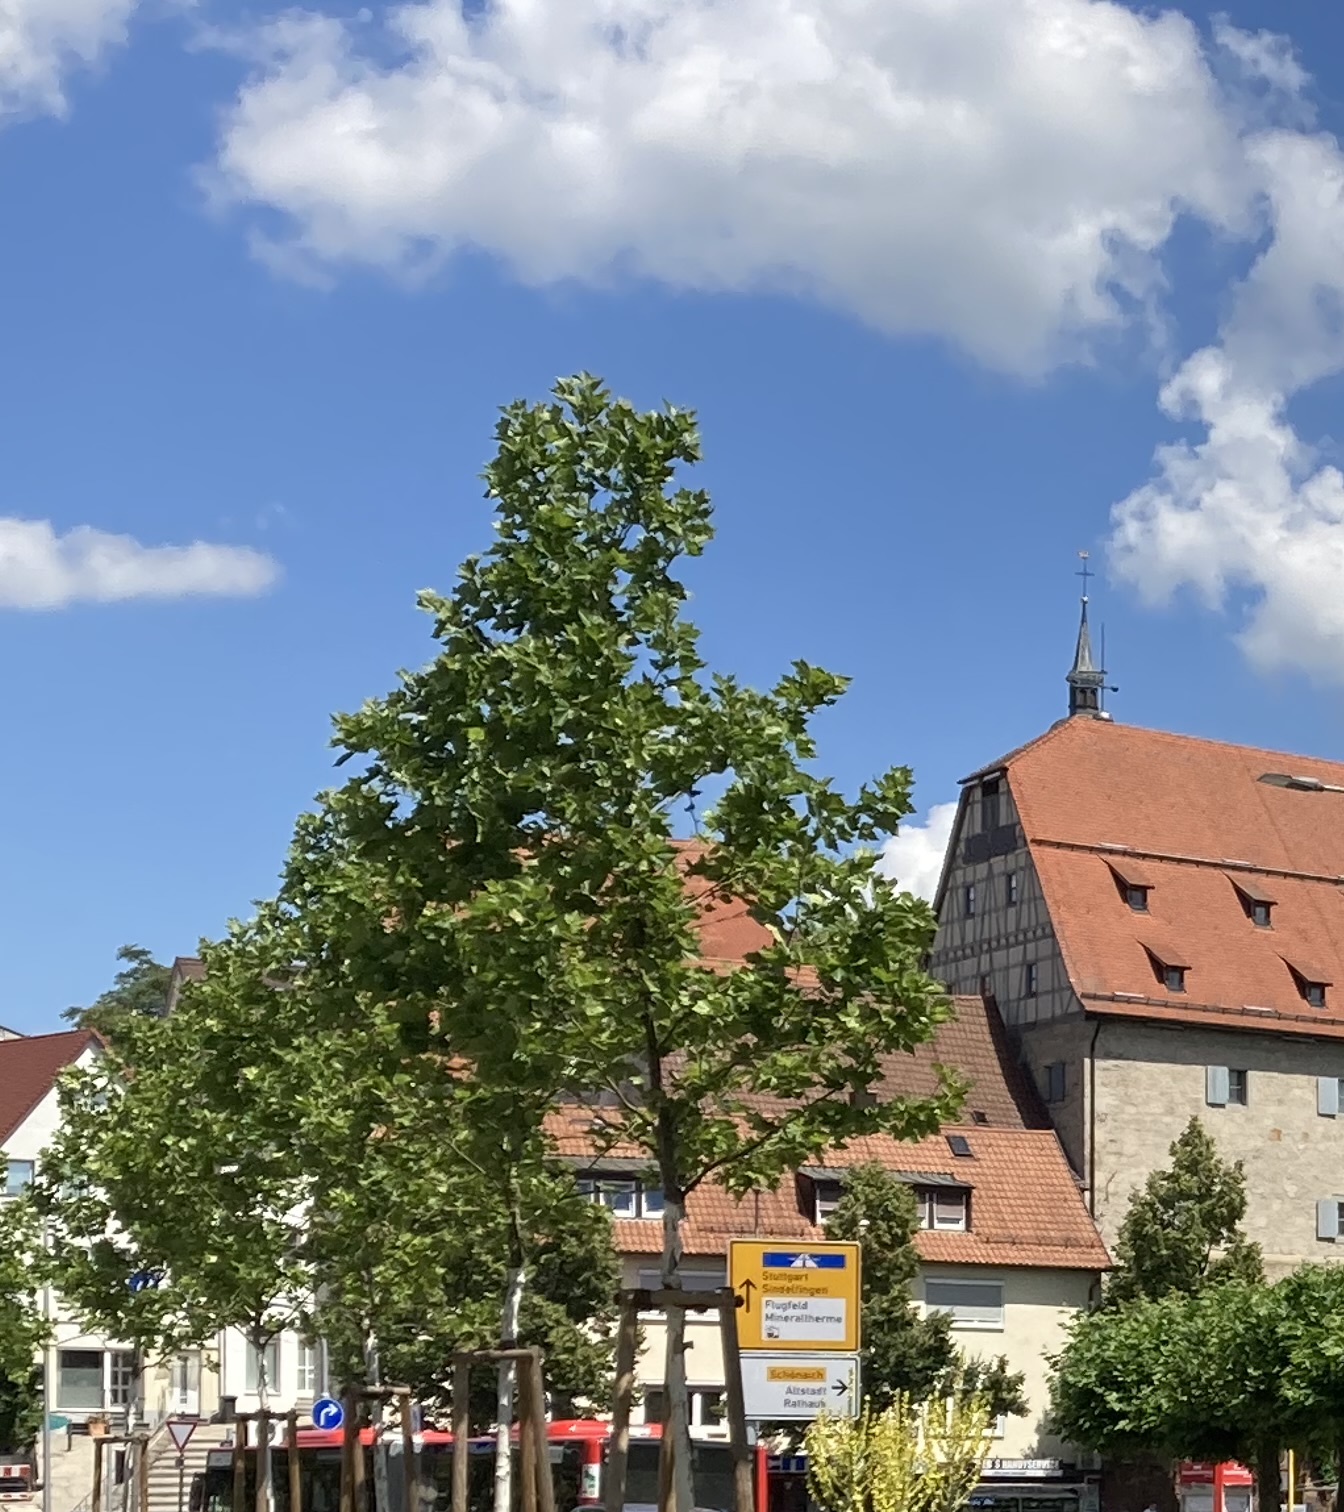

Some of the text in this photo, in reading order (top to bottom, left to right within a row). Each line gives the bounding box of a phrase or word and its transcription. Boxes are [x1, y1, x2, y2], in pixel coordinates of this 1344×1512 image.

[762, 1271, 808, 1283] Stuttgart
[762, 1284, 828, 1296] Sindelfingen
[765, 1300, 808, 1312] Flugfeld
[765, 1313, 842, 1323] Mineraltherme
[785, 1385, 826, 1395] Altstadt
[783, 1398, 825, 1408] Rathaus
